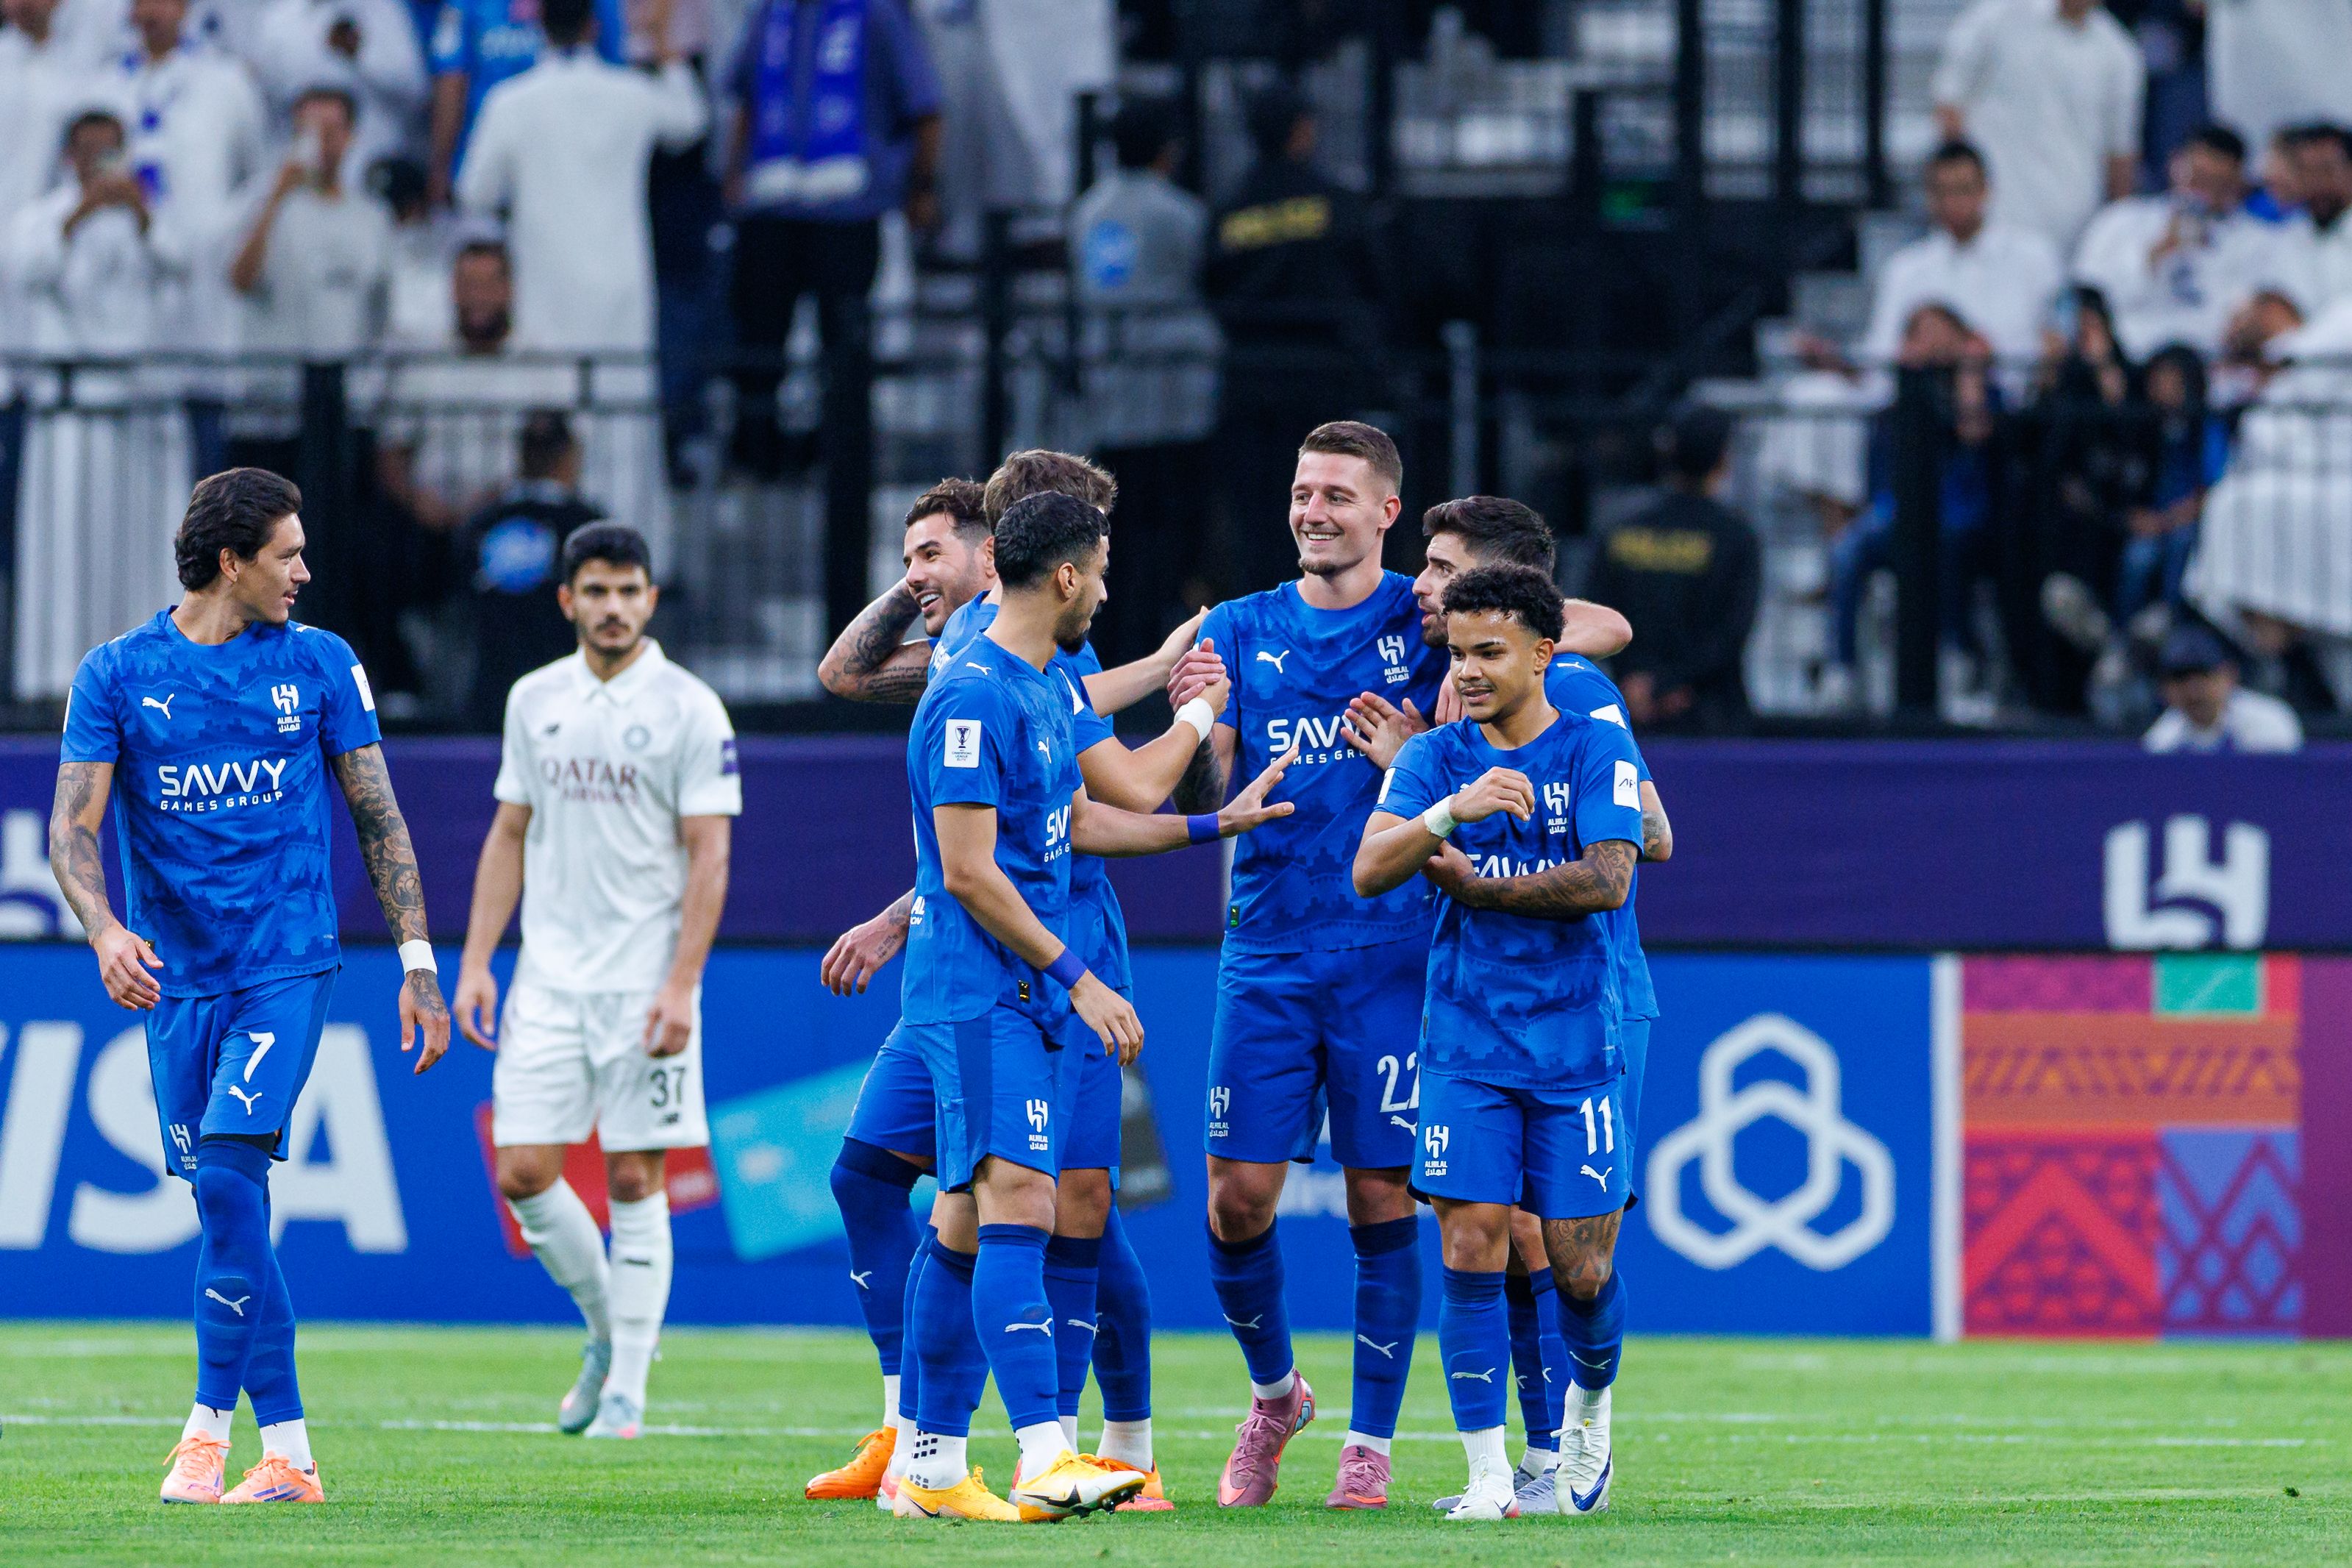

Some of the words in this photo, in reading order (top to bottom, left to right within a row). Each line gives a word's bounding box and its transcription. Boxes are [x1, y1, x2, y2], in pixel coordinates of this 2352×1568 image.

[158, 758, 287, 797] SAVVY
[540, 756, 638, 793] QATAR
[160, 800, 218, 812] GAMES
[226, 791, 283, 808] GROUP
[243, 1031, 276, 1083] 7
[649, 1066, 687, 1108] 37
[0, 1021, 408, 1255] ISA
[1579, 1094, 1614, 1156] 11
